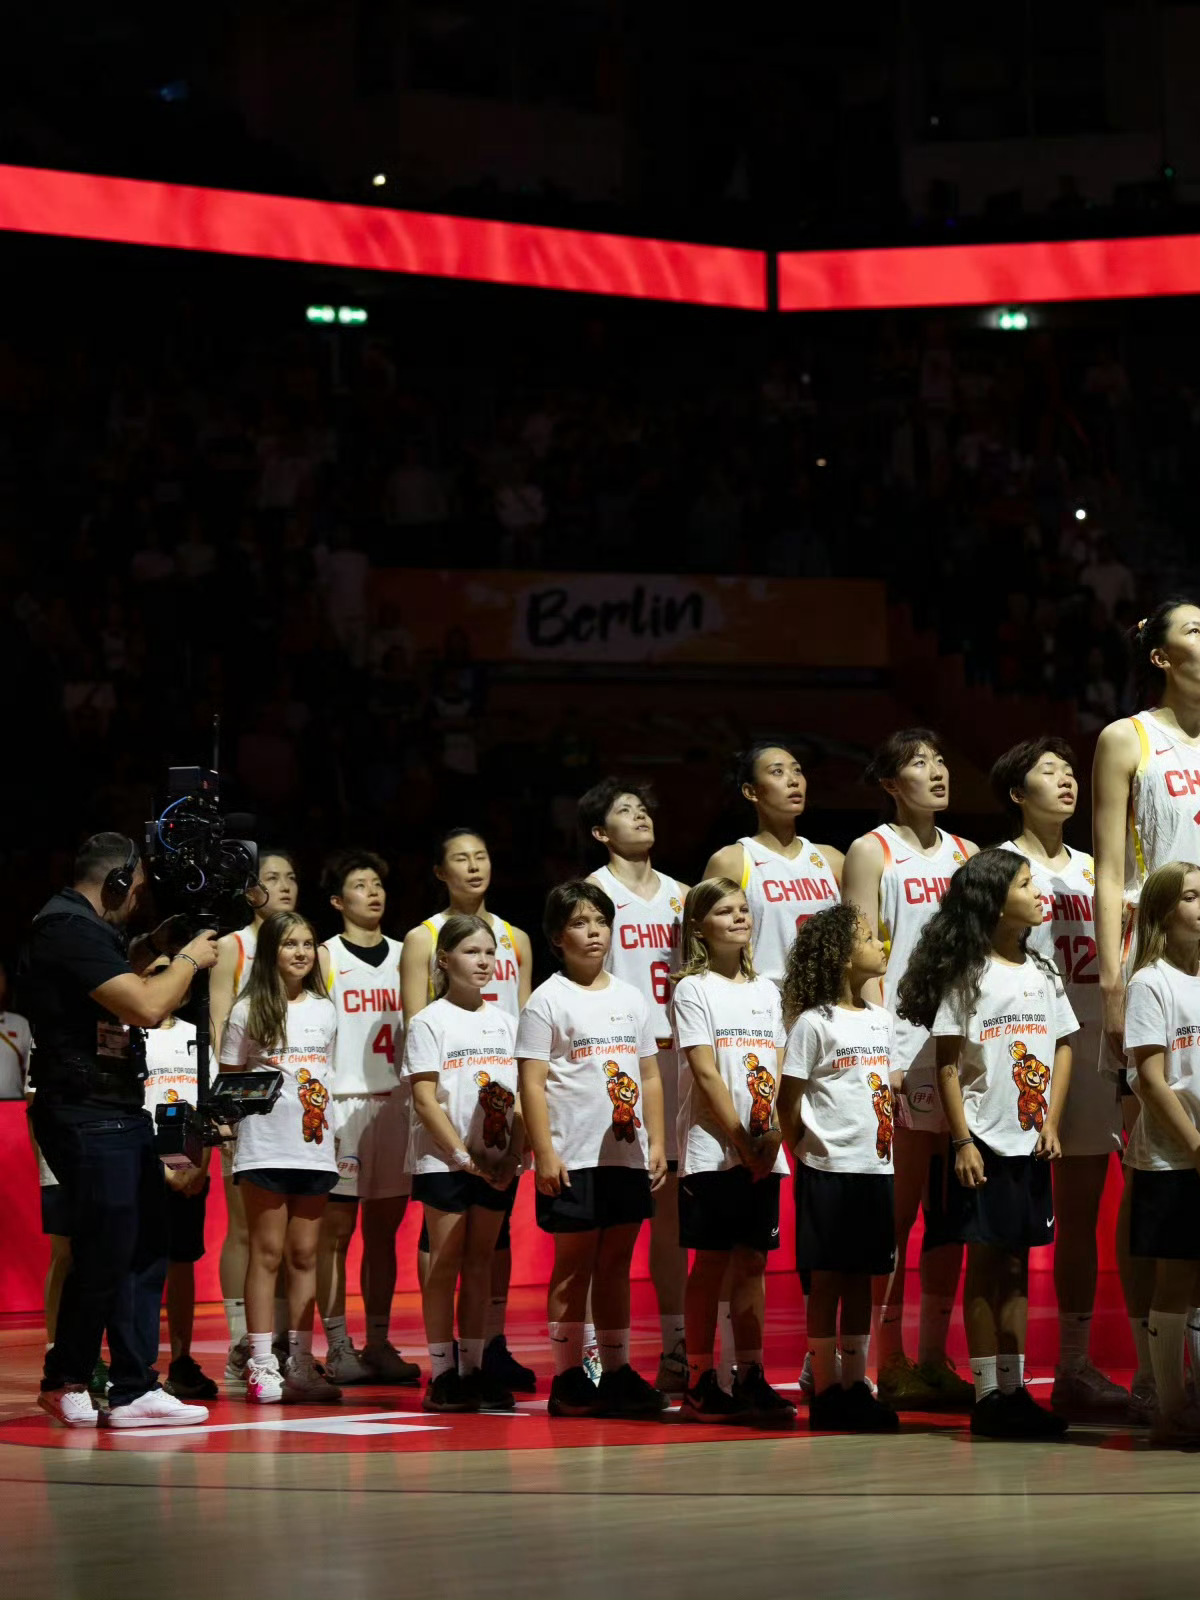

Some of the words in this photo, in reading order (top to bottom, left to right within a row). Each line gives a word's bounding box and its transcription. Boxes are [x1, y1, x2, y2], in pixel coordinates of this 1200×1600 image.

[527, 585, 703, 646] Berlin
[762, 877, 837, 903] CHINA
[904, 877, 952, 905] CHI
[1040, 894, 1096, 922] CHIN
[1055, 935, 1100, 984] 12
[650, 961, 671, 1005] 6
[983, 1013, 1021, 1027] BASKETBALL
[1022, 1014, 1033, 1022] FOR
[751, 1029, 762, 1037] FOR
[764, 1030, 774, 1038] GOO
[980, 1026, 1001, 1042] LITTLE
[1004, 1023, 1047, 1035] CHAMPION
[372, 1023, 396, 1064] 4
[573, 1037, 611, 1048] BASKETBALL
[736, 1037, 776, 1049] CHAMPION
[1171, 1036, 1194, 1051] LITTLE
[447, 1048, 483, 1058] BASKETBALL
[483, 1047, 494, 1055] FOR
[571, 1045, 593, 1059] LITTLE
[595, 1043, 637, 1055] CHAMPION
[836, 1046, 872, 1057] BASKETBALL
[872, 1046, 884, 1054] FOR
[442, 1057, 464, 1070] LITTLE
[467, 1056, 513, 1066] CHAMPIONS
[832, 1055, 858, 1069] LITTLE
